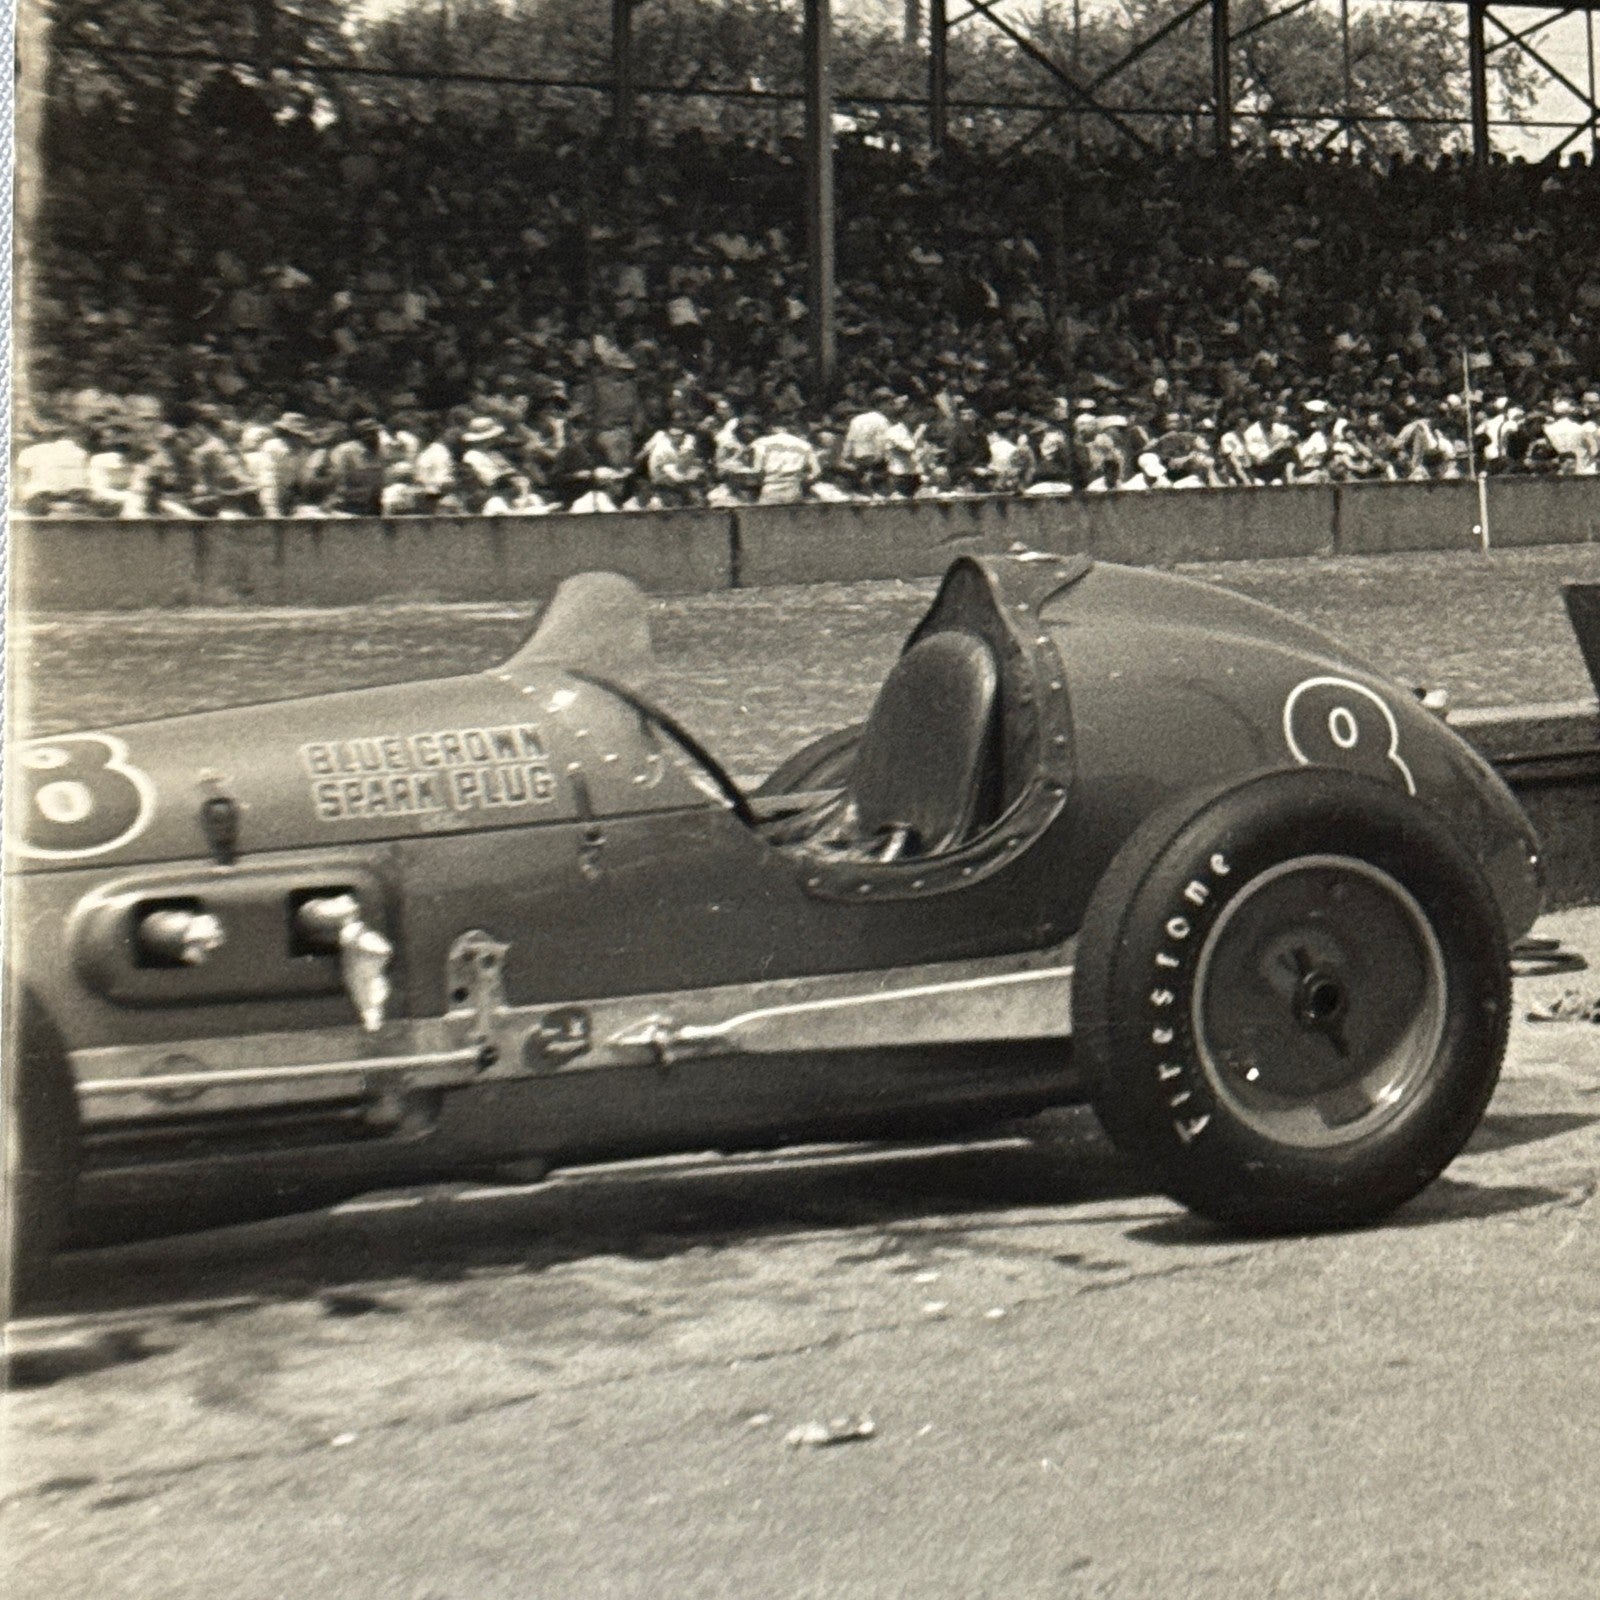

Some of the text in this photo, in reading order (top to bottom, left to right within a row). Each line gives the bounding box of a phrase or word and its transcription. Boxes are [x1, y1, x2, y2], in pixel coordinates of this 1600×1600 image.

[301, 723, 549, 777] BLUE CROWN
[313, 764, 556, 821] SPARK PLUG
[1150, 853, 1231, 1143] Firestone
